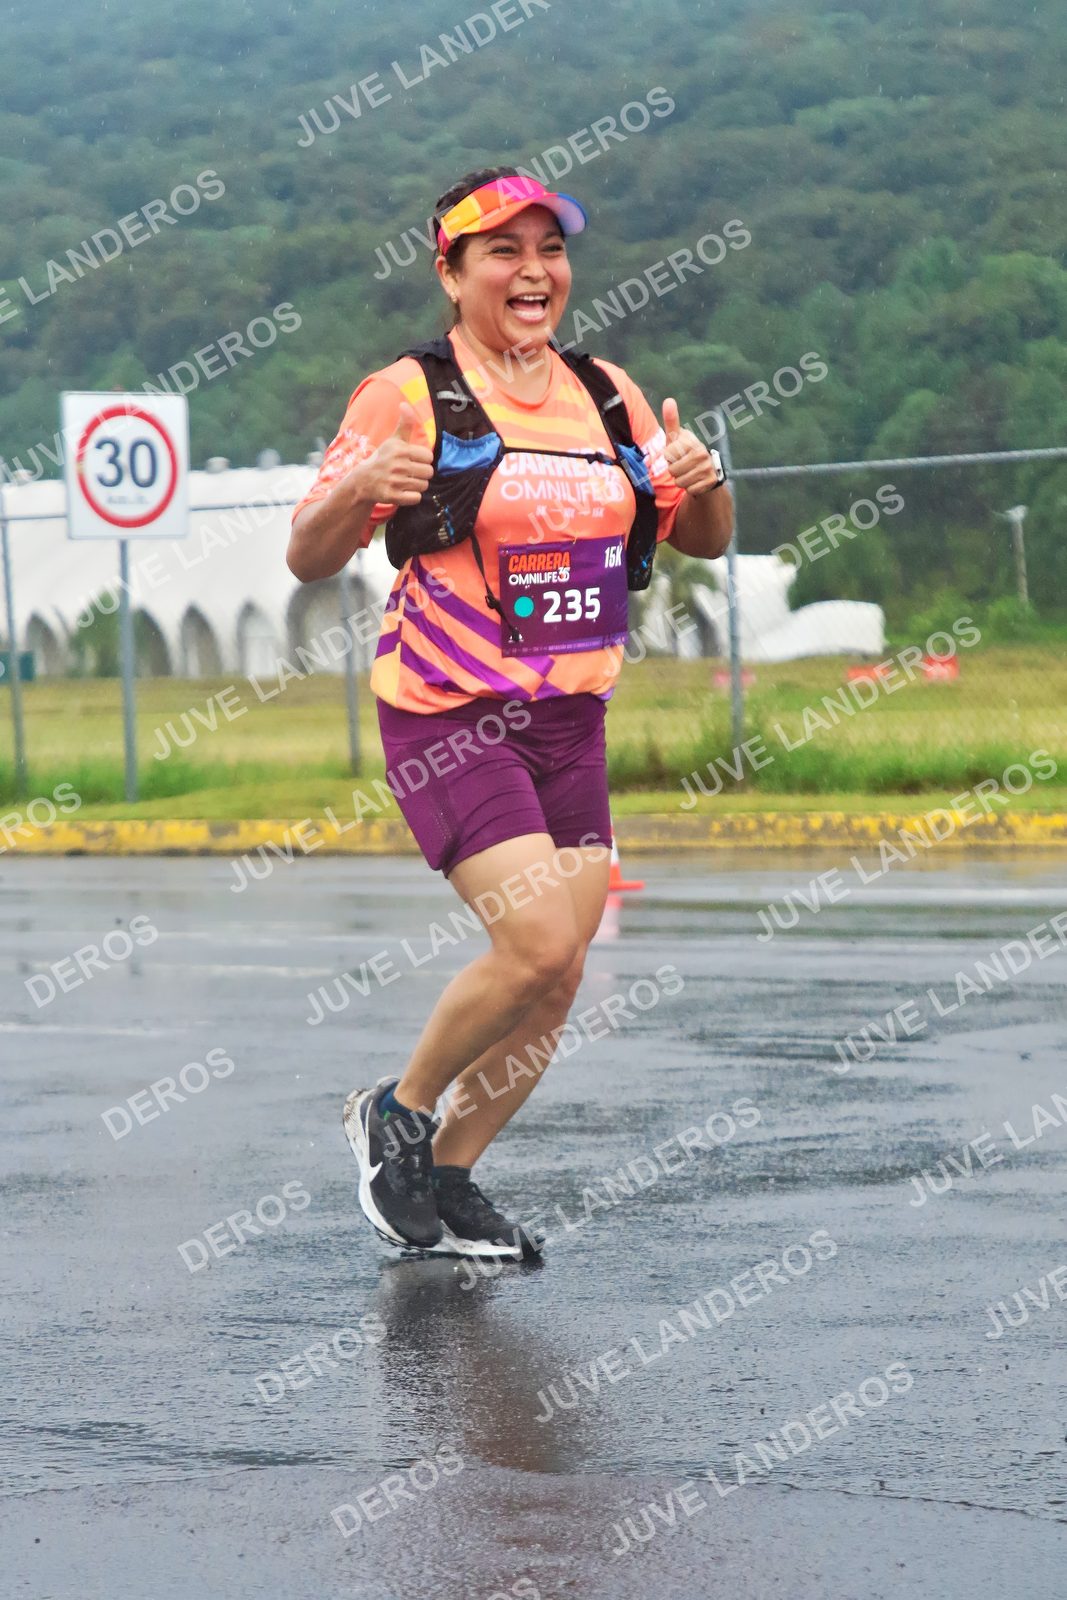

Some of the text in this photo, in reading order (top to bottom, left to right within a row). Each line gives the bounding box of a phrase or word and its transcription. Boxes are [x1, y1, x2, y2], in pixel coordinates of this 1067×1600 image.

[95, 438, 158, 488] 30
[508, 552, 570, 573] CARRERA
[543, 587, 601, 623] 235
